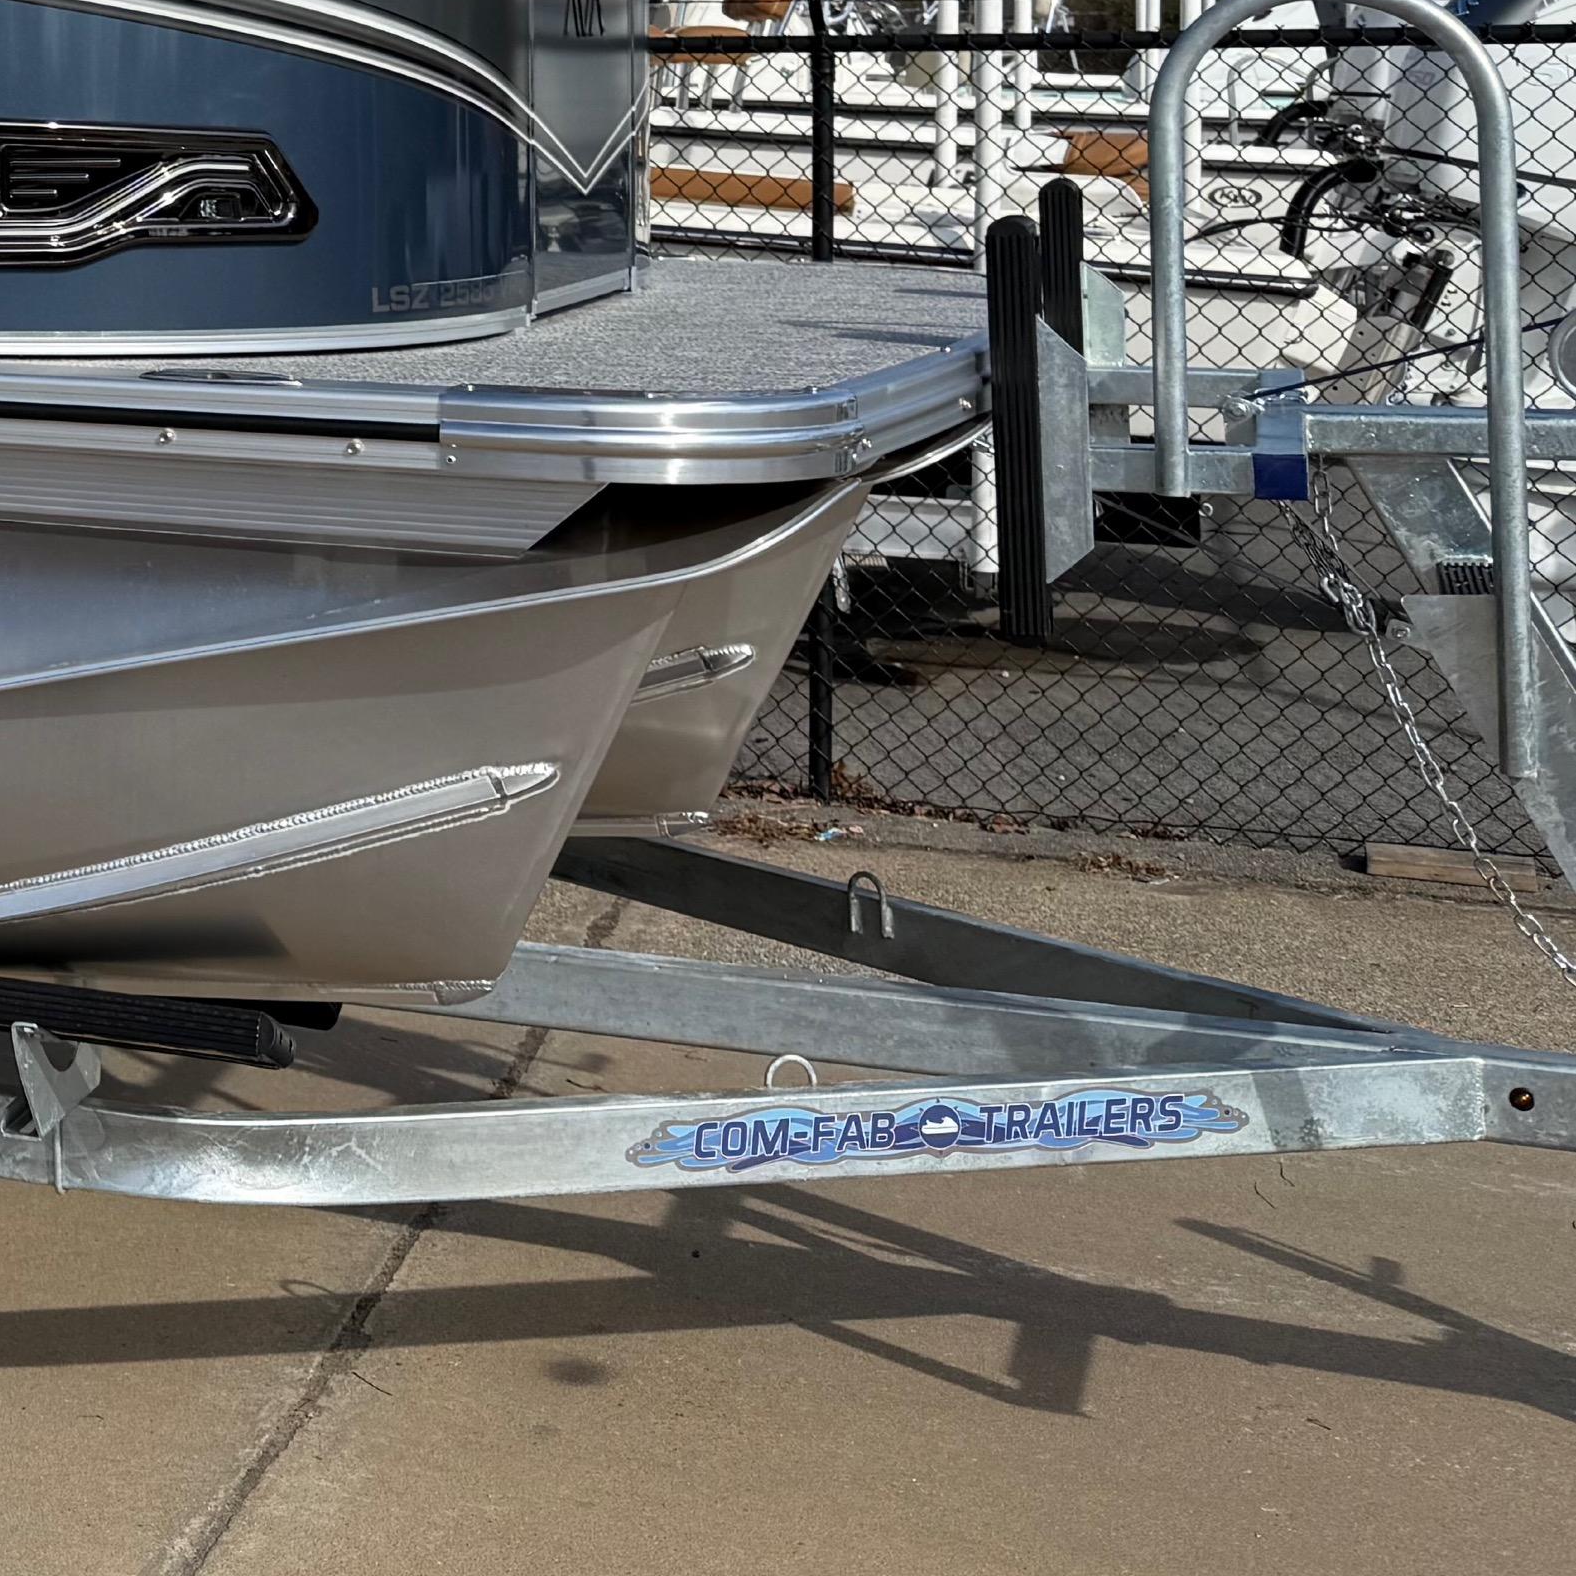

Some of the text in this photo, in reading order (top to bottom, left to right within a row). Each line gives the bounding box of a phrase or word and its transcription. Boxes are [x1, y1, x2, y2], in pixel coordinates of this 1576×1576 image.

[372, 284, 430, 313] LSZ
[693, 1093, 1186, 1160] COM-FAB TRAILERS
